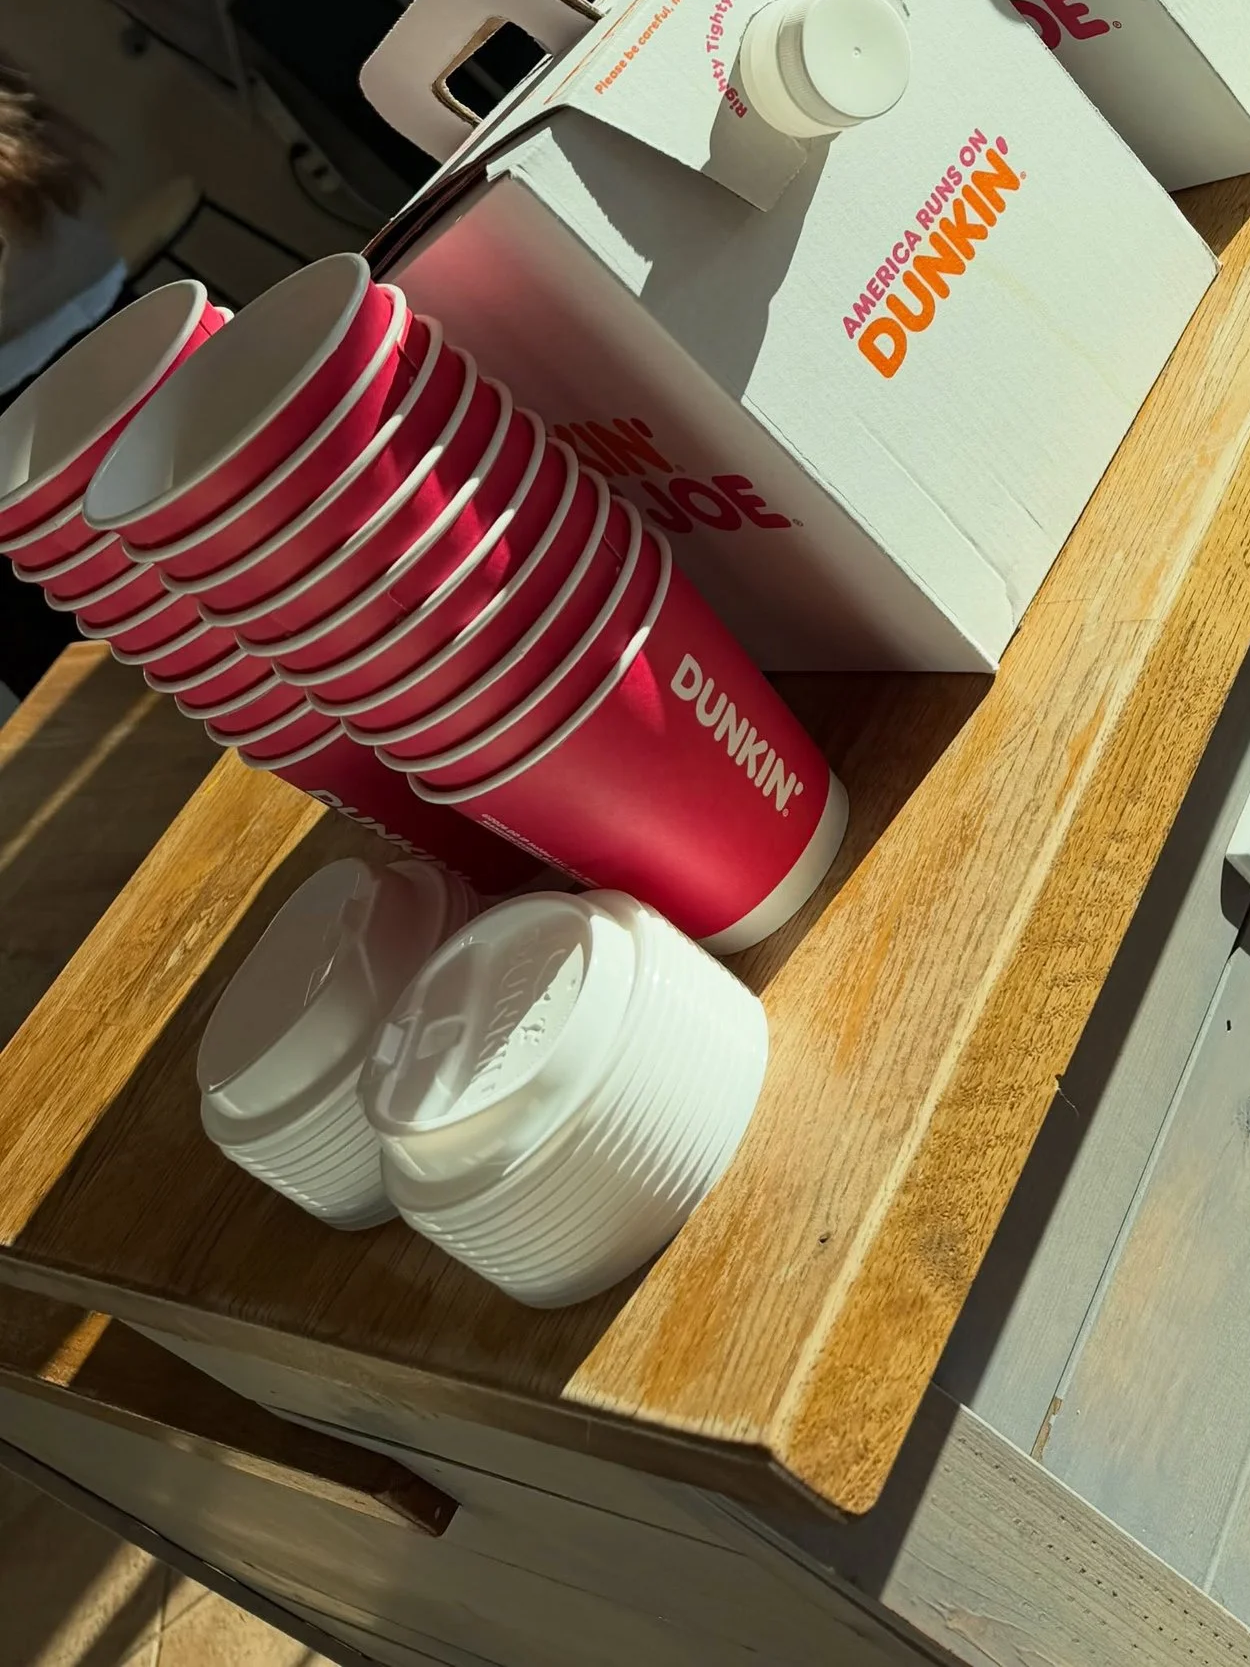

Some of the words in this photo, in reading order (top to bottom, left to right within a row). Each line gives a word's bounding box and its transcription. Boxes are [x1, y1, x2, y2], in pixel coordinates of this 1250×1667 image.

[595, 60, 627, 94] Please
[624, 45, 639, 60] be
[638, 5, 674, 45] careful,
[711, 58, 748, 119] Righty
[843, 230, 922, 339] AMERICA
[915, 165, 963, 231] RUNS
[959, 128, 988, 168] ON
[641, 474, 793, 534] JOE
